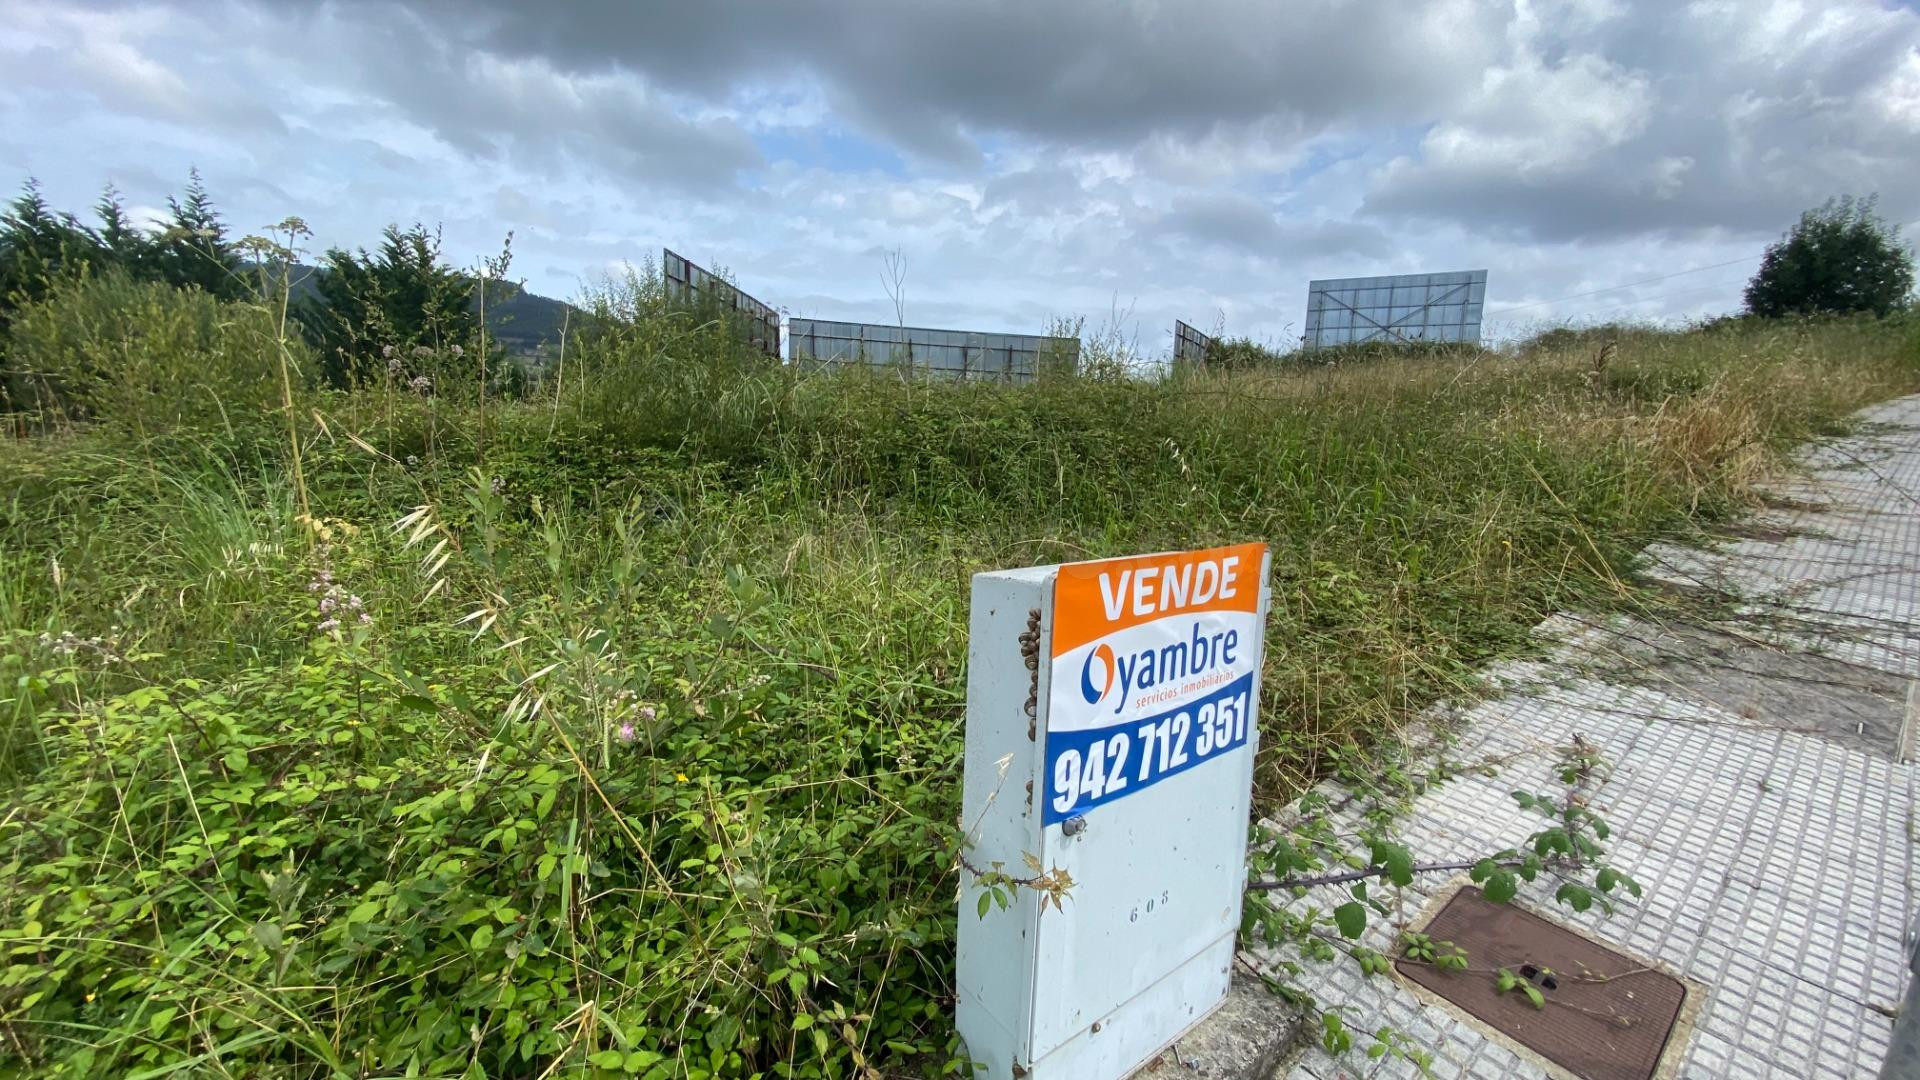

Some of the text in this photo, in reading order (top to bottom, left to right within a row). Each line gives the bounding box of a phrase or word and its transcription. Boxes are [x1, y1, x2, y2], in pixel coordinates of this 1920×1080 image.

[1098, 556, 1239, 622] VENDE
[1081, 622, 1238, 714] Oyambre
[1136, 670, 1234, 708] servicios inmobiliarios
[1053, 691, 1247, 813] 942 712 351
